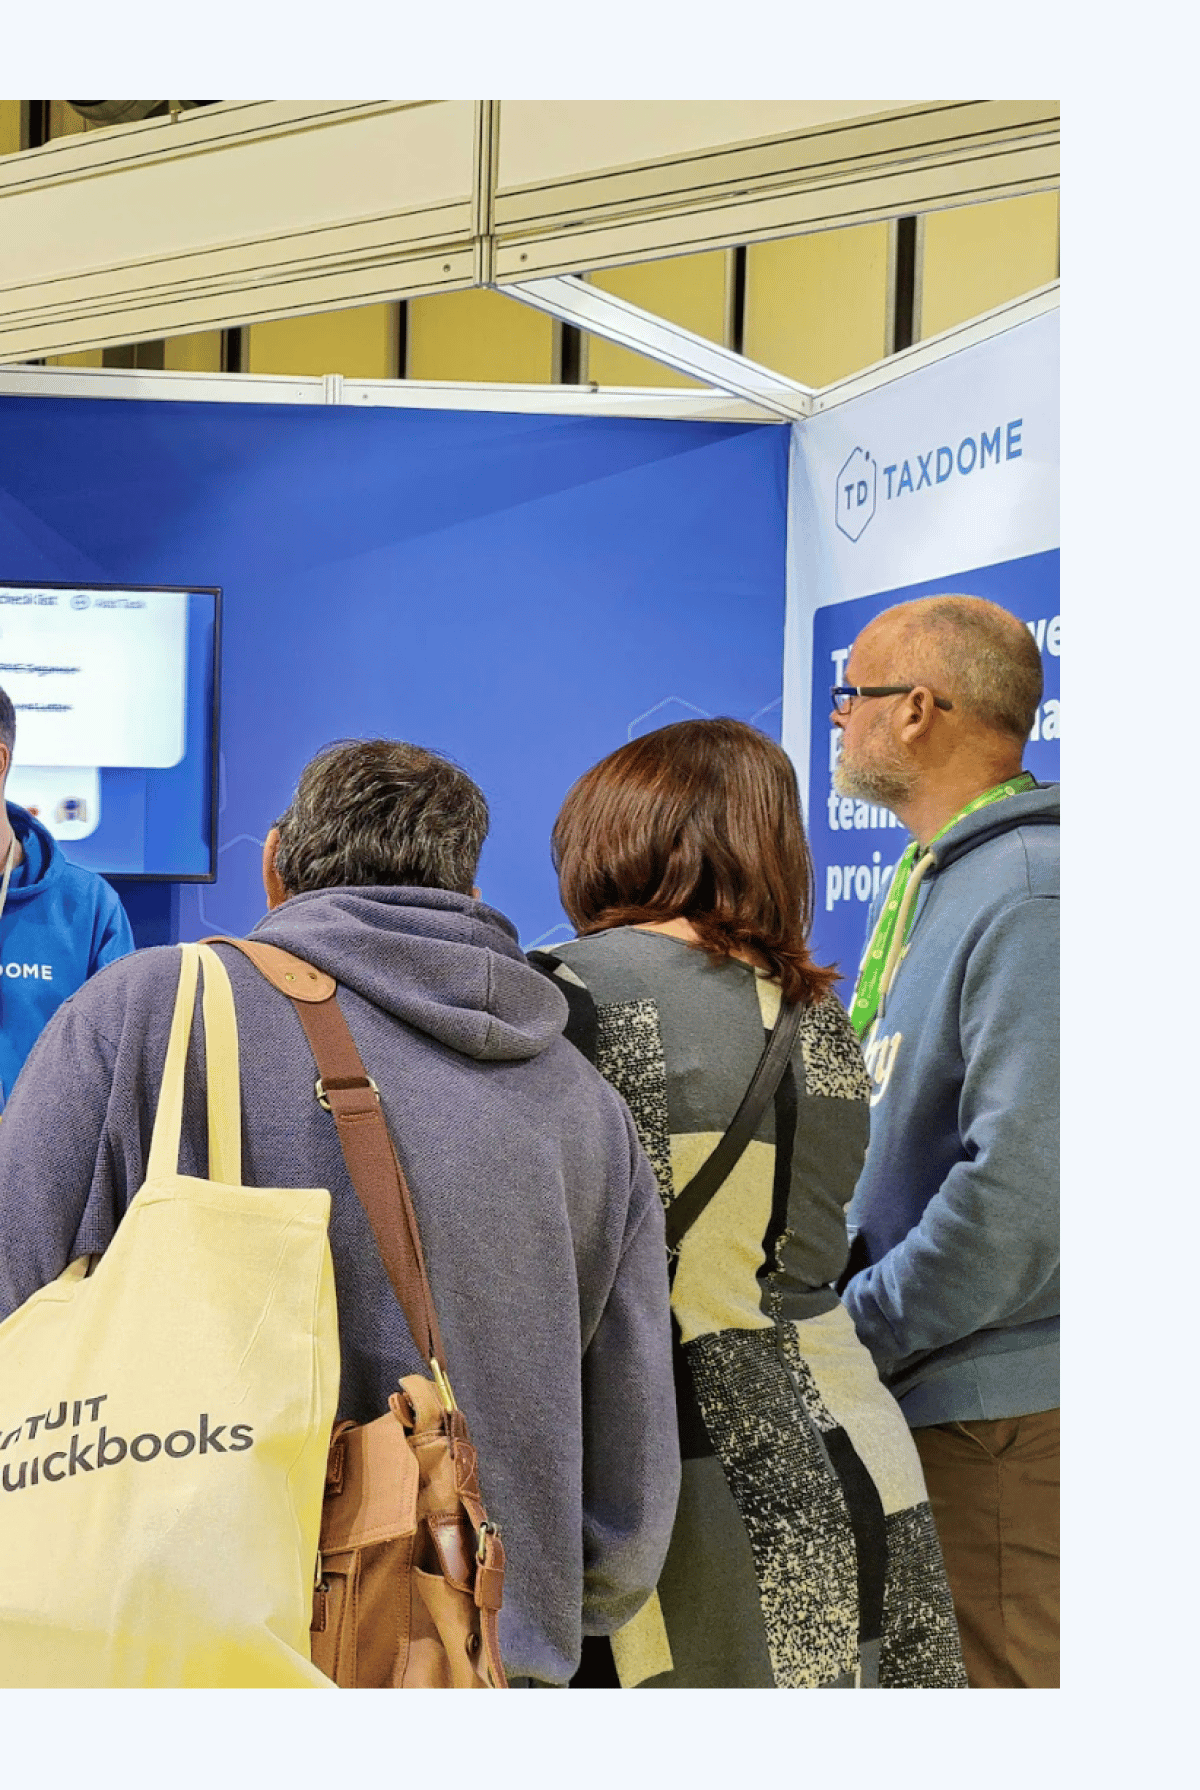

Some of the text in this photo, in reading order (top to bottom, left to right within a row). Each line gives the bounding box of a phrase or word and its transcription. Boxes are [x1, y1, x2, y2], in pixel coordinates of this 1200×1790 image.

[844, 418, 1023, 510] TD TAXDOME
[827, 788, 906, 830] team
